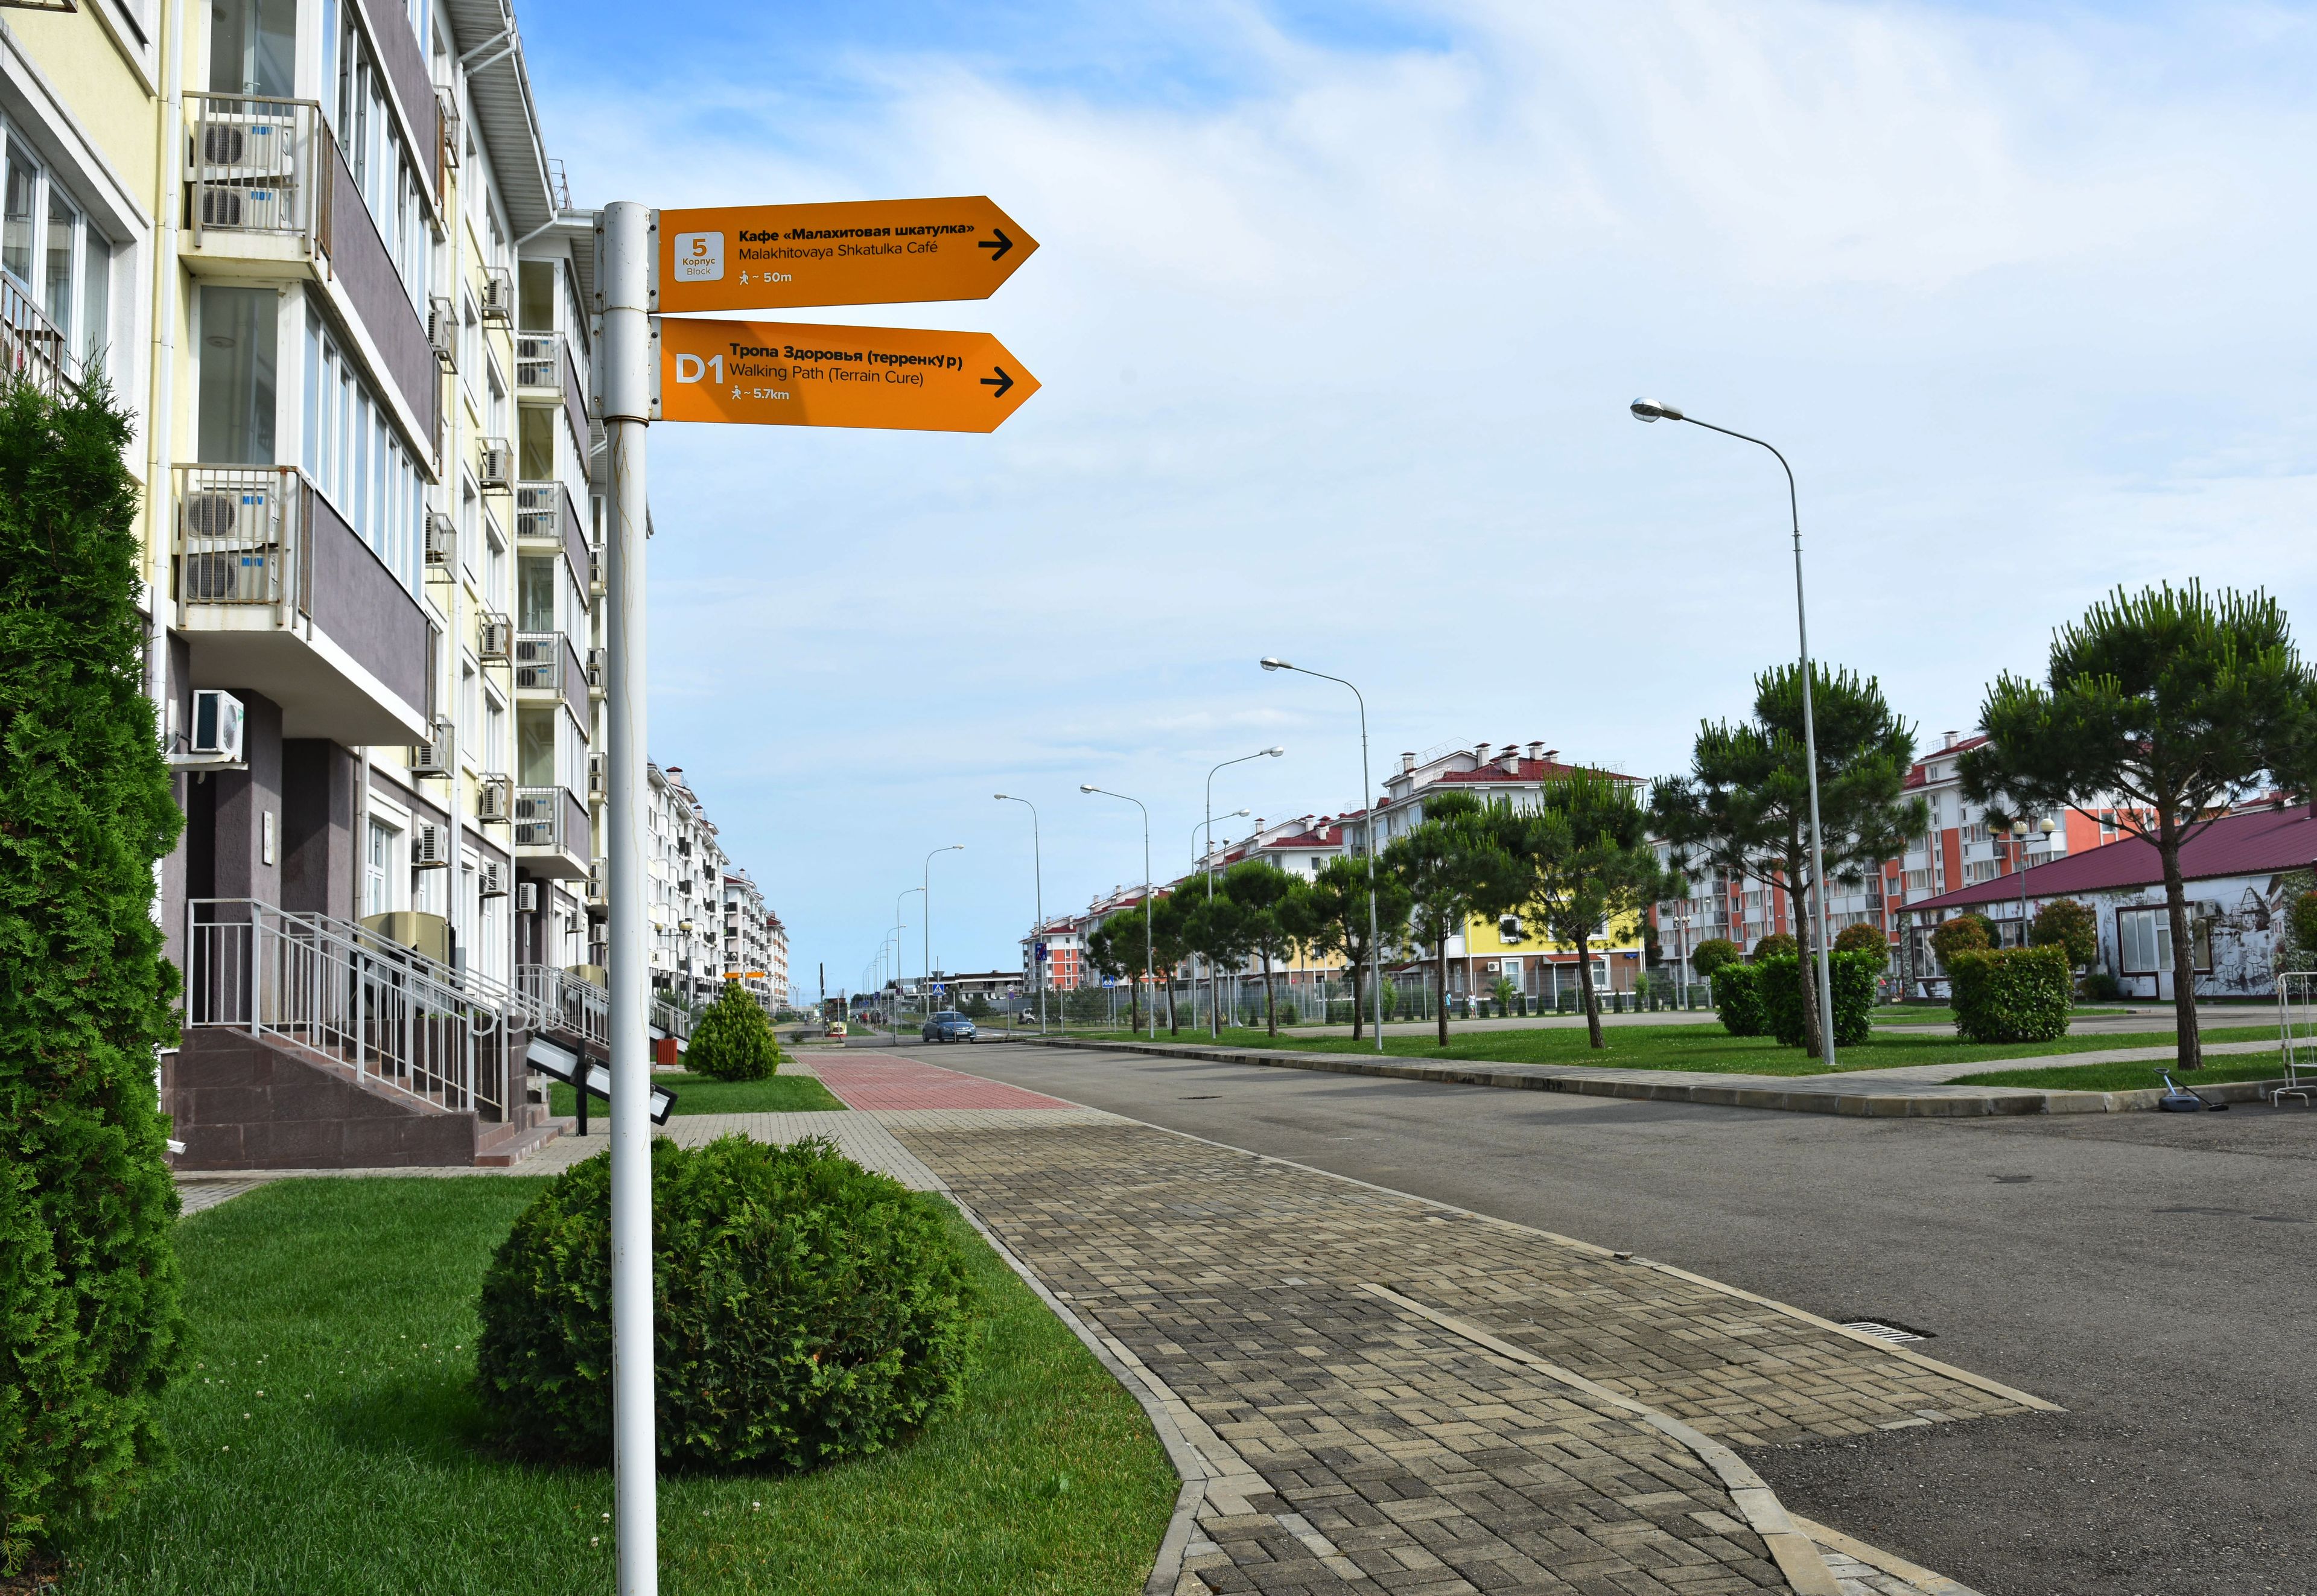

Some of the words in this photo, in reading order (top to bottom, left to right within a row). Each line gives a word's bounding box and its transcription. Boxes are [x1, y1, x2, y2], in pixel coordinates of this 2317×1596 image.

[739, 230, 779, 244] Кафе
[783, 227, 890, 240] «Малахитовая
[895, 224, 974, 237] шкатулка»
[692, 238, 707, 256] 5
[739, 247, 833, 260] Malakhitovaya
[837, 243, 902, 256] Shkatulka
[907, 240, 938, 253] Café
[682, 257, 715, 267] Корпус
[764, 272, 792, 282] 50m
[729, 343, 778, 359] Тропа
[784, 346, 863, 363] Здоровья
[676, 354, 723, 384] D1
[729, 363, 787, 381] Walking
[793, 366, 824, 380] Path
[829, 367, 880, 383] (Terrain
[885, 370, 923, 387] Cure)
[754, 388, 789, 400] 5.7km
